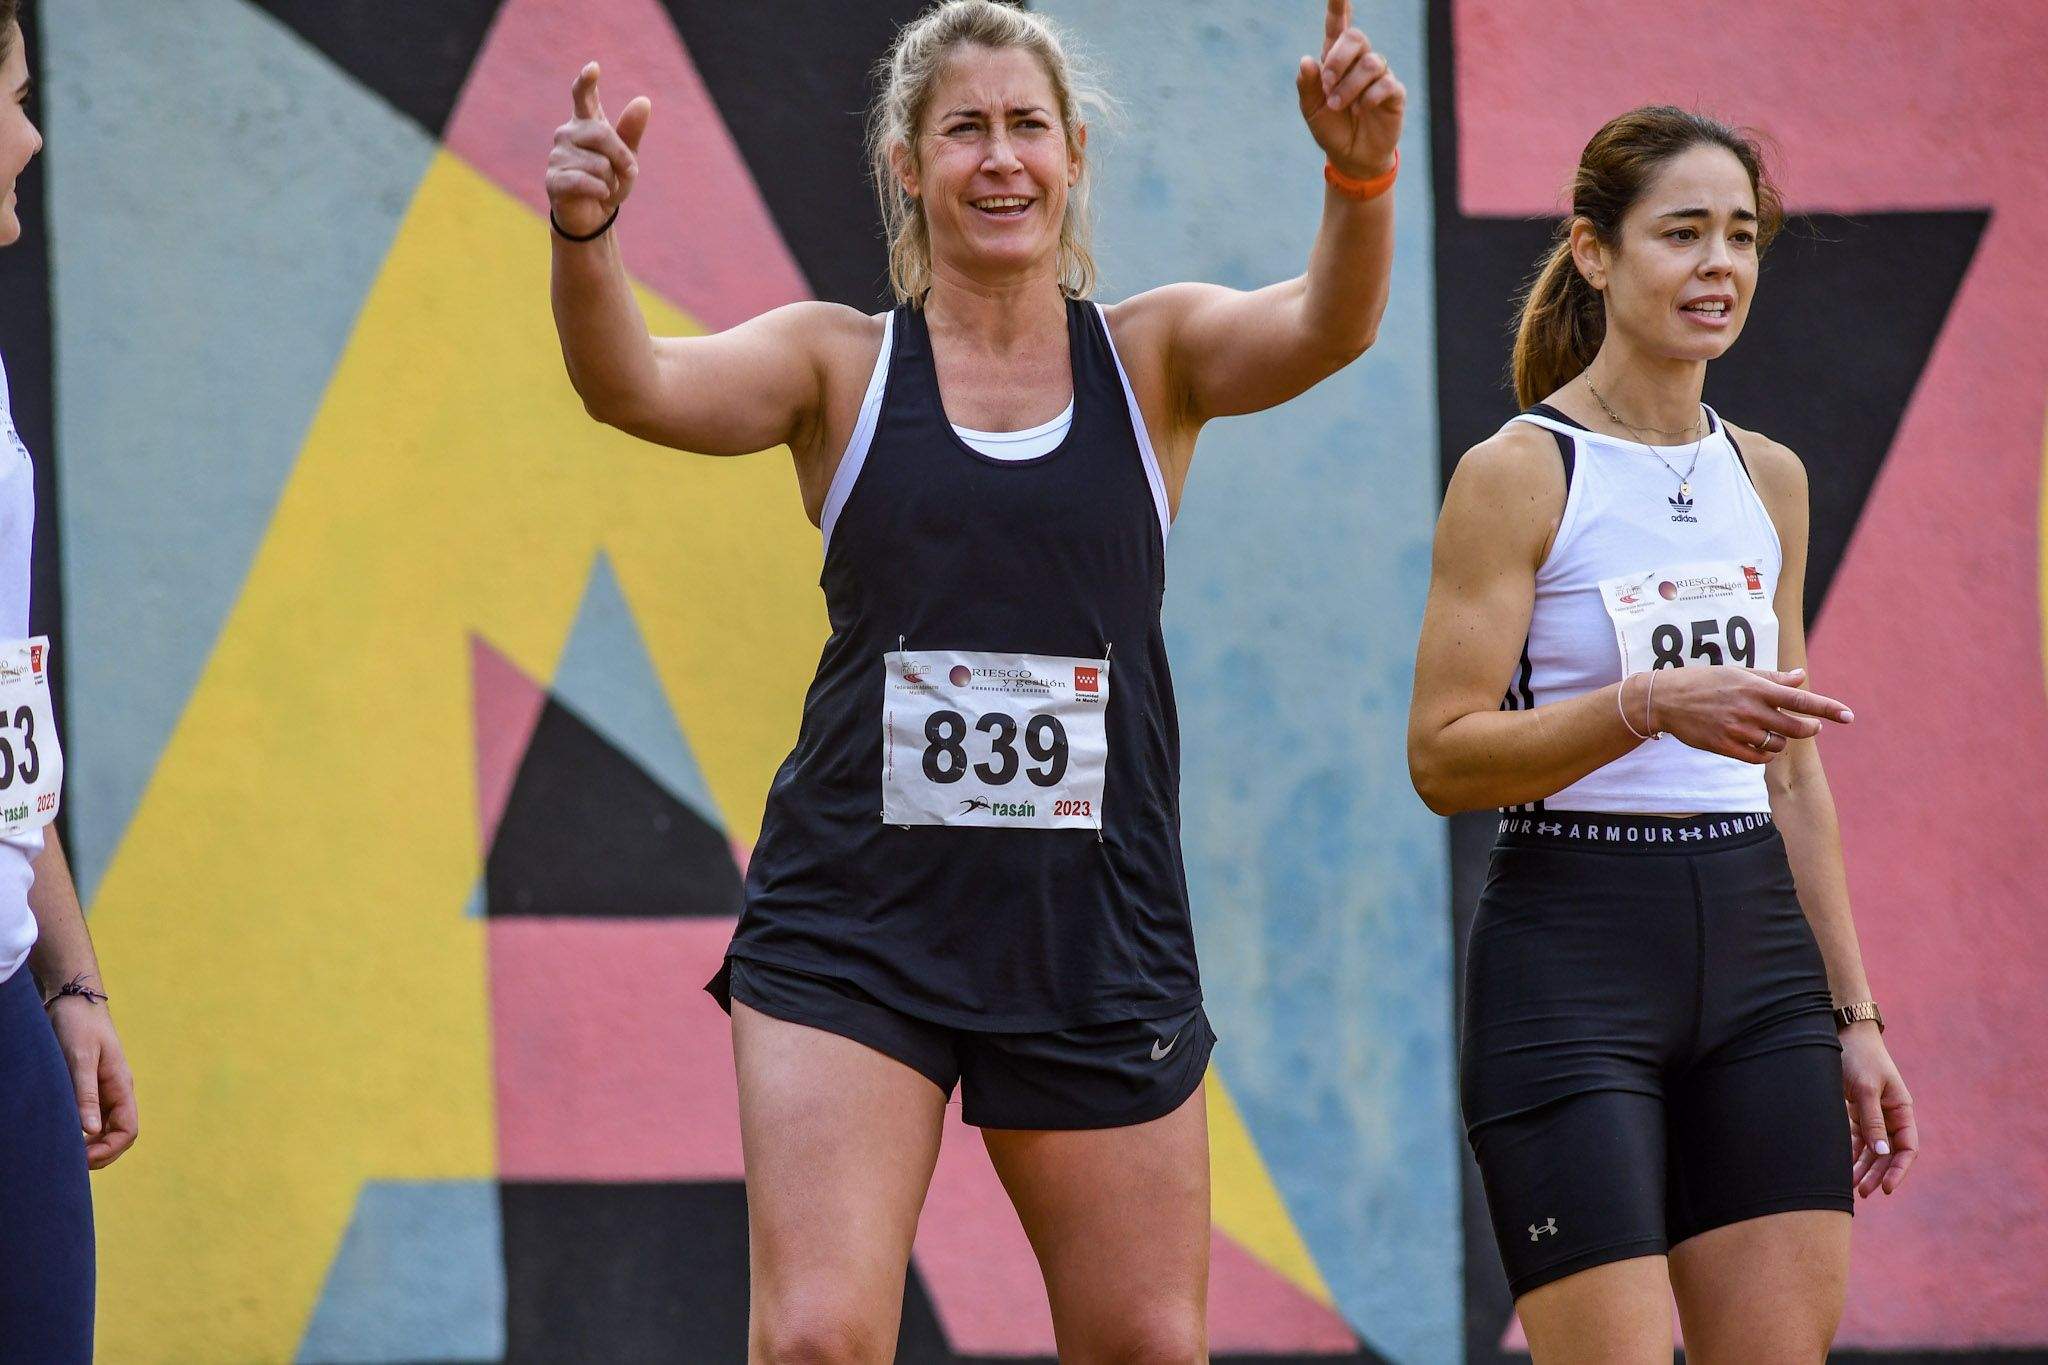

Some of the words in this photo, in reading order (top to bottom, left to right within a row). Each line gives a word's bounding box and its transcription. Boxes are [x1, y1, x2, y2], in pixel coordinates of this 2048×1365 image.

[1671, 514, 1697, 523] adidas
[1676, 576, 1718, 589] RIESGO
[1651, 615, 1756, 671] 859
[972, 668, 1032, 679] RIESGO
[1003, 678, 1010, 688] y
[1016, 677, 1066, 689] gestión
[922, 710, 1068, 787] 839
[37, 792, 56, 813] 2023
[992, 799, 1036, 817] rasán
[1053, 800, 1091, 816] 2023
[4, 801, 29, 823] rasán
[1568, 823, 1674, 843] ARMOUR
